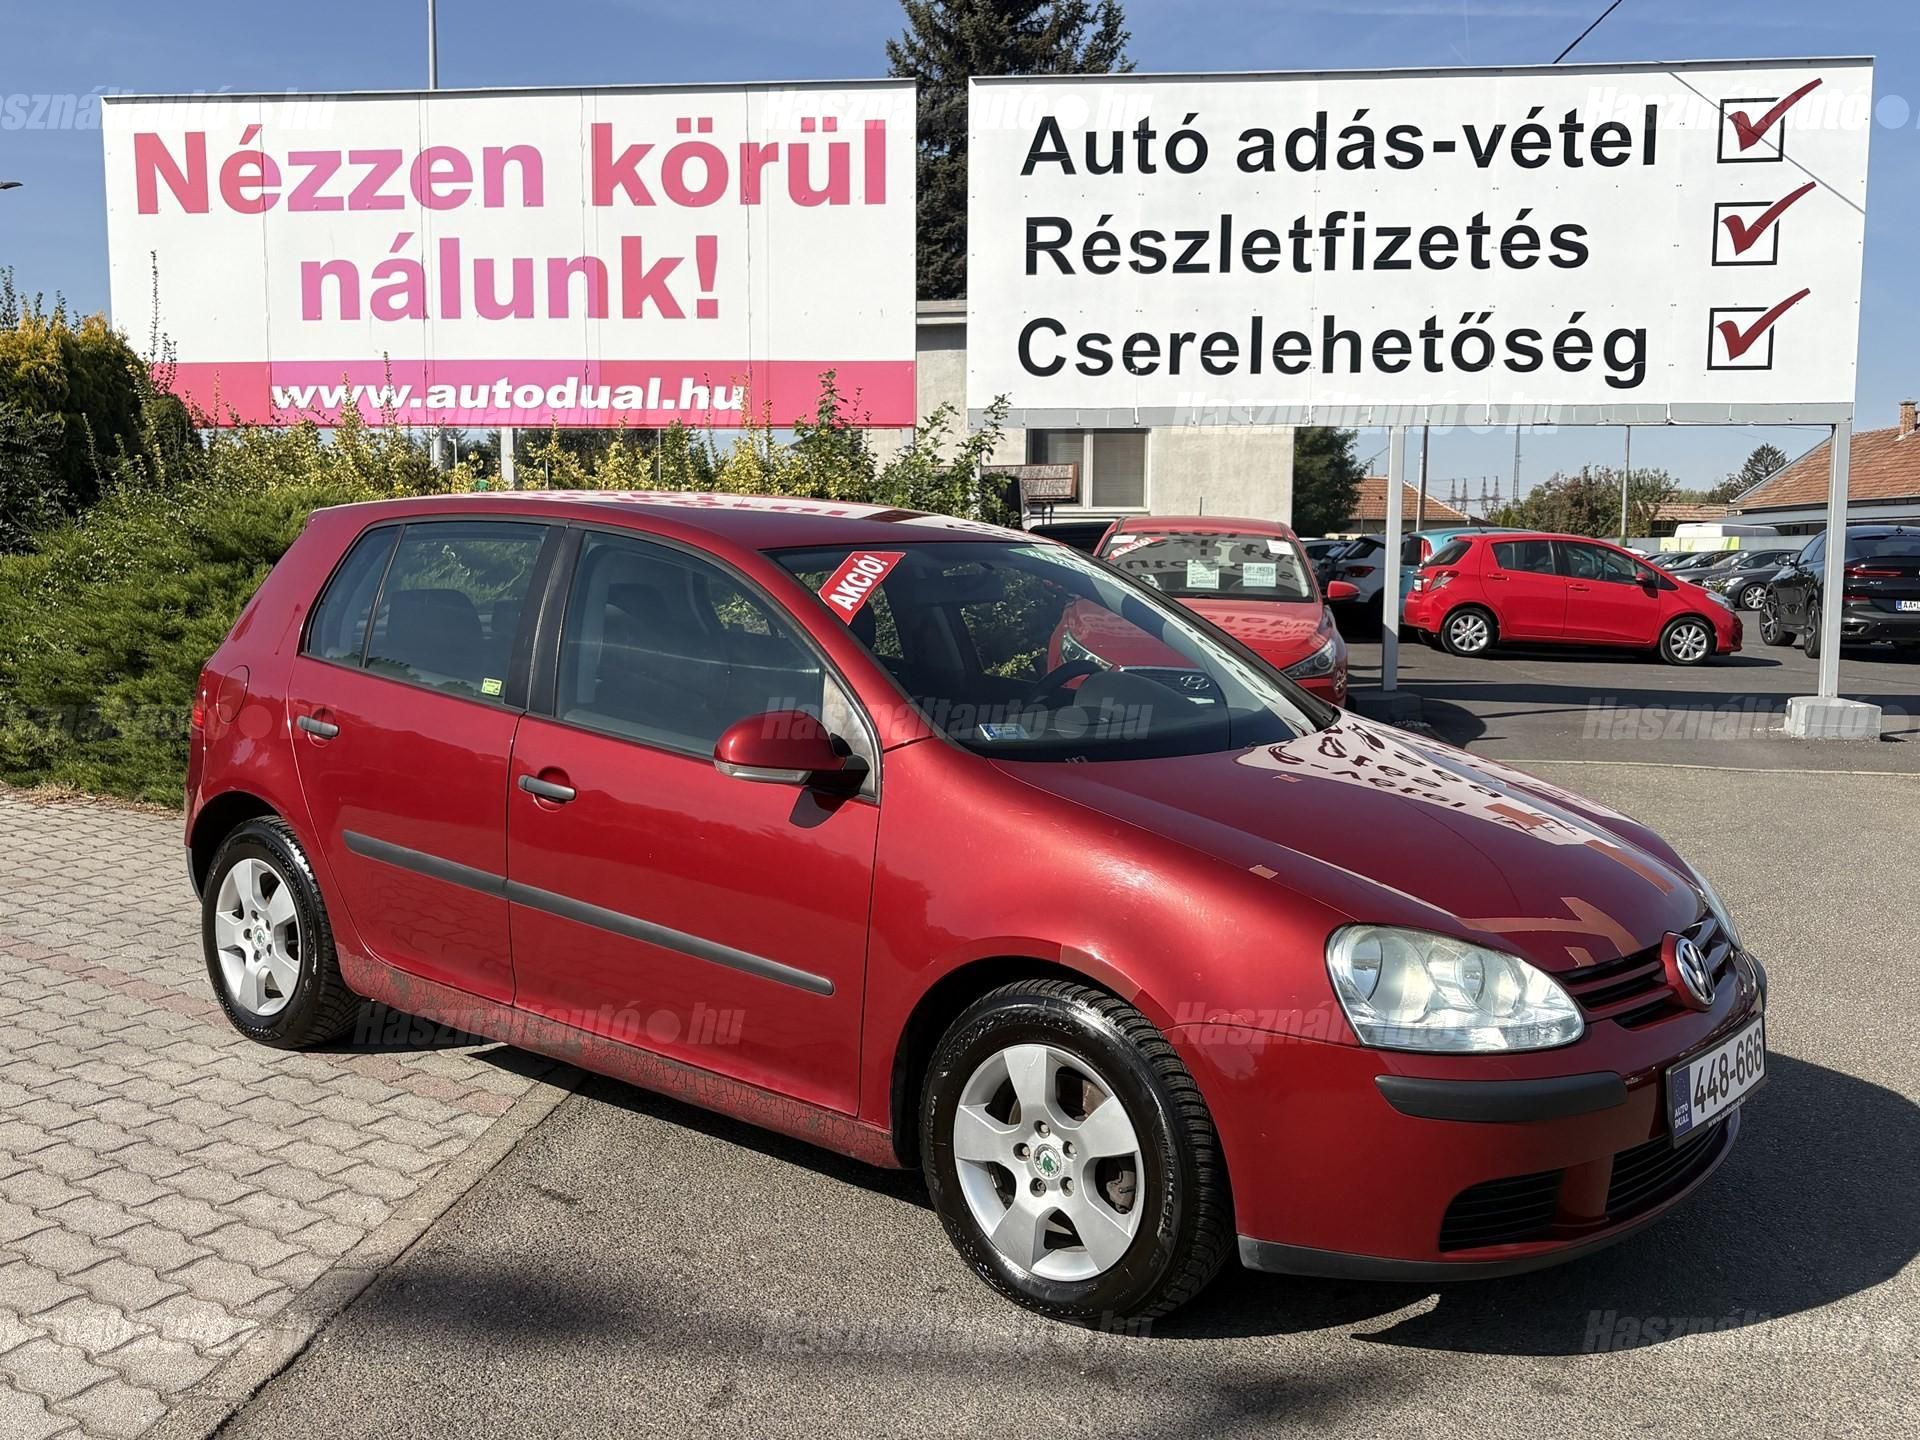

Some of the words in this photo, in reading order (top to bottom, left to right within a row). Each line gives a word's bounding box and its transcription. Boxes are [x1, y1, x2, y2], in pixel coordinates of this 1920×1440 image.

[134, 124, 544, 215] Nézzen
[591, 116, 886, 207] körül
[1020, 112, 1209, 176] Autó
[1236, 104, 1658, 173] adás-vétel
[301, 232, 719, 321] nálunk!
[1025, 208, 1589, 276] Részletfizetés
[1018, 311, 1647, 389] Cserelehetőség
[271, 376, 745, 411] www.autodual.hu
[828, 554, 889, 612] AKCIÓ!
[1693, 1027, 1762, 1114] 448-666
